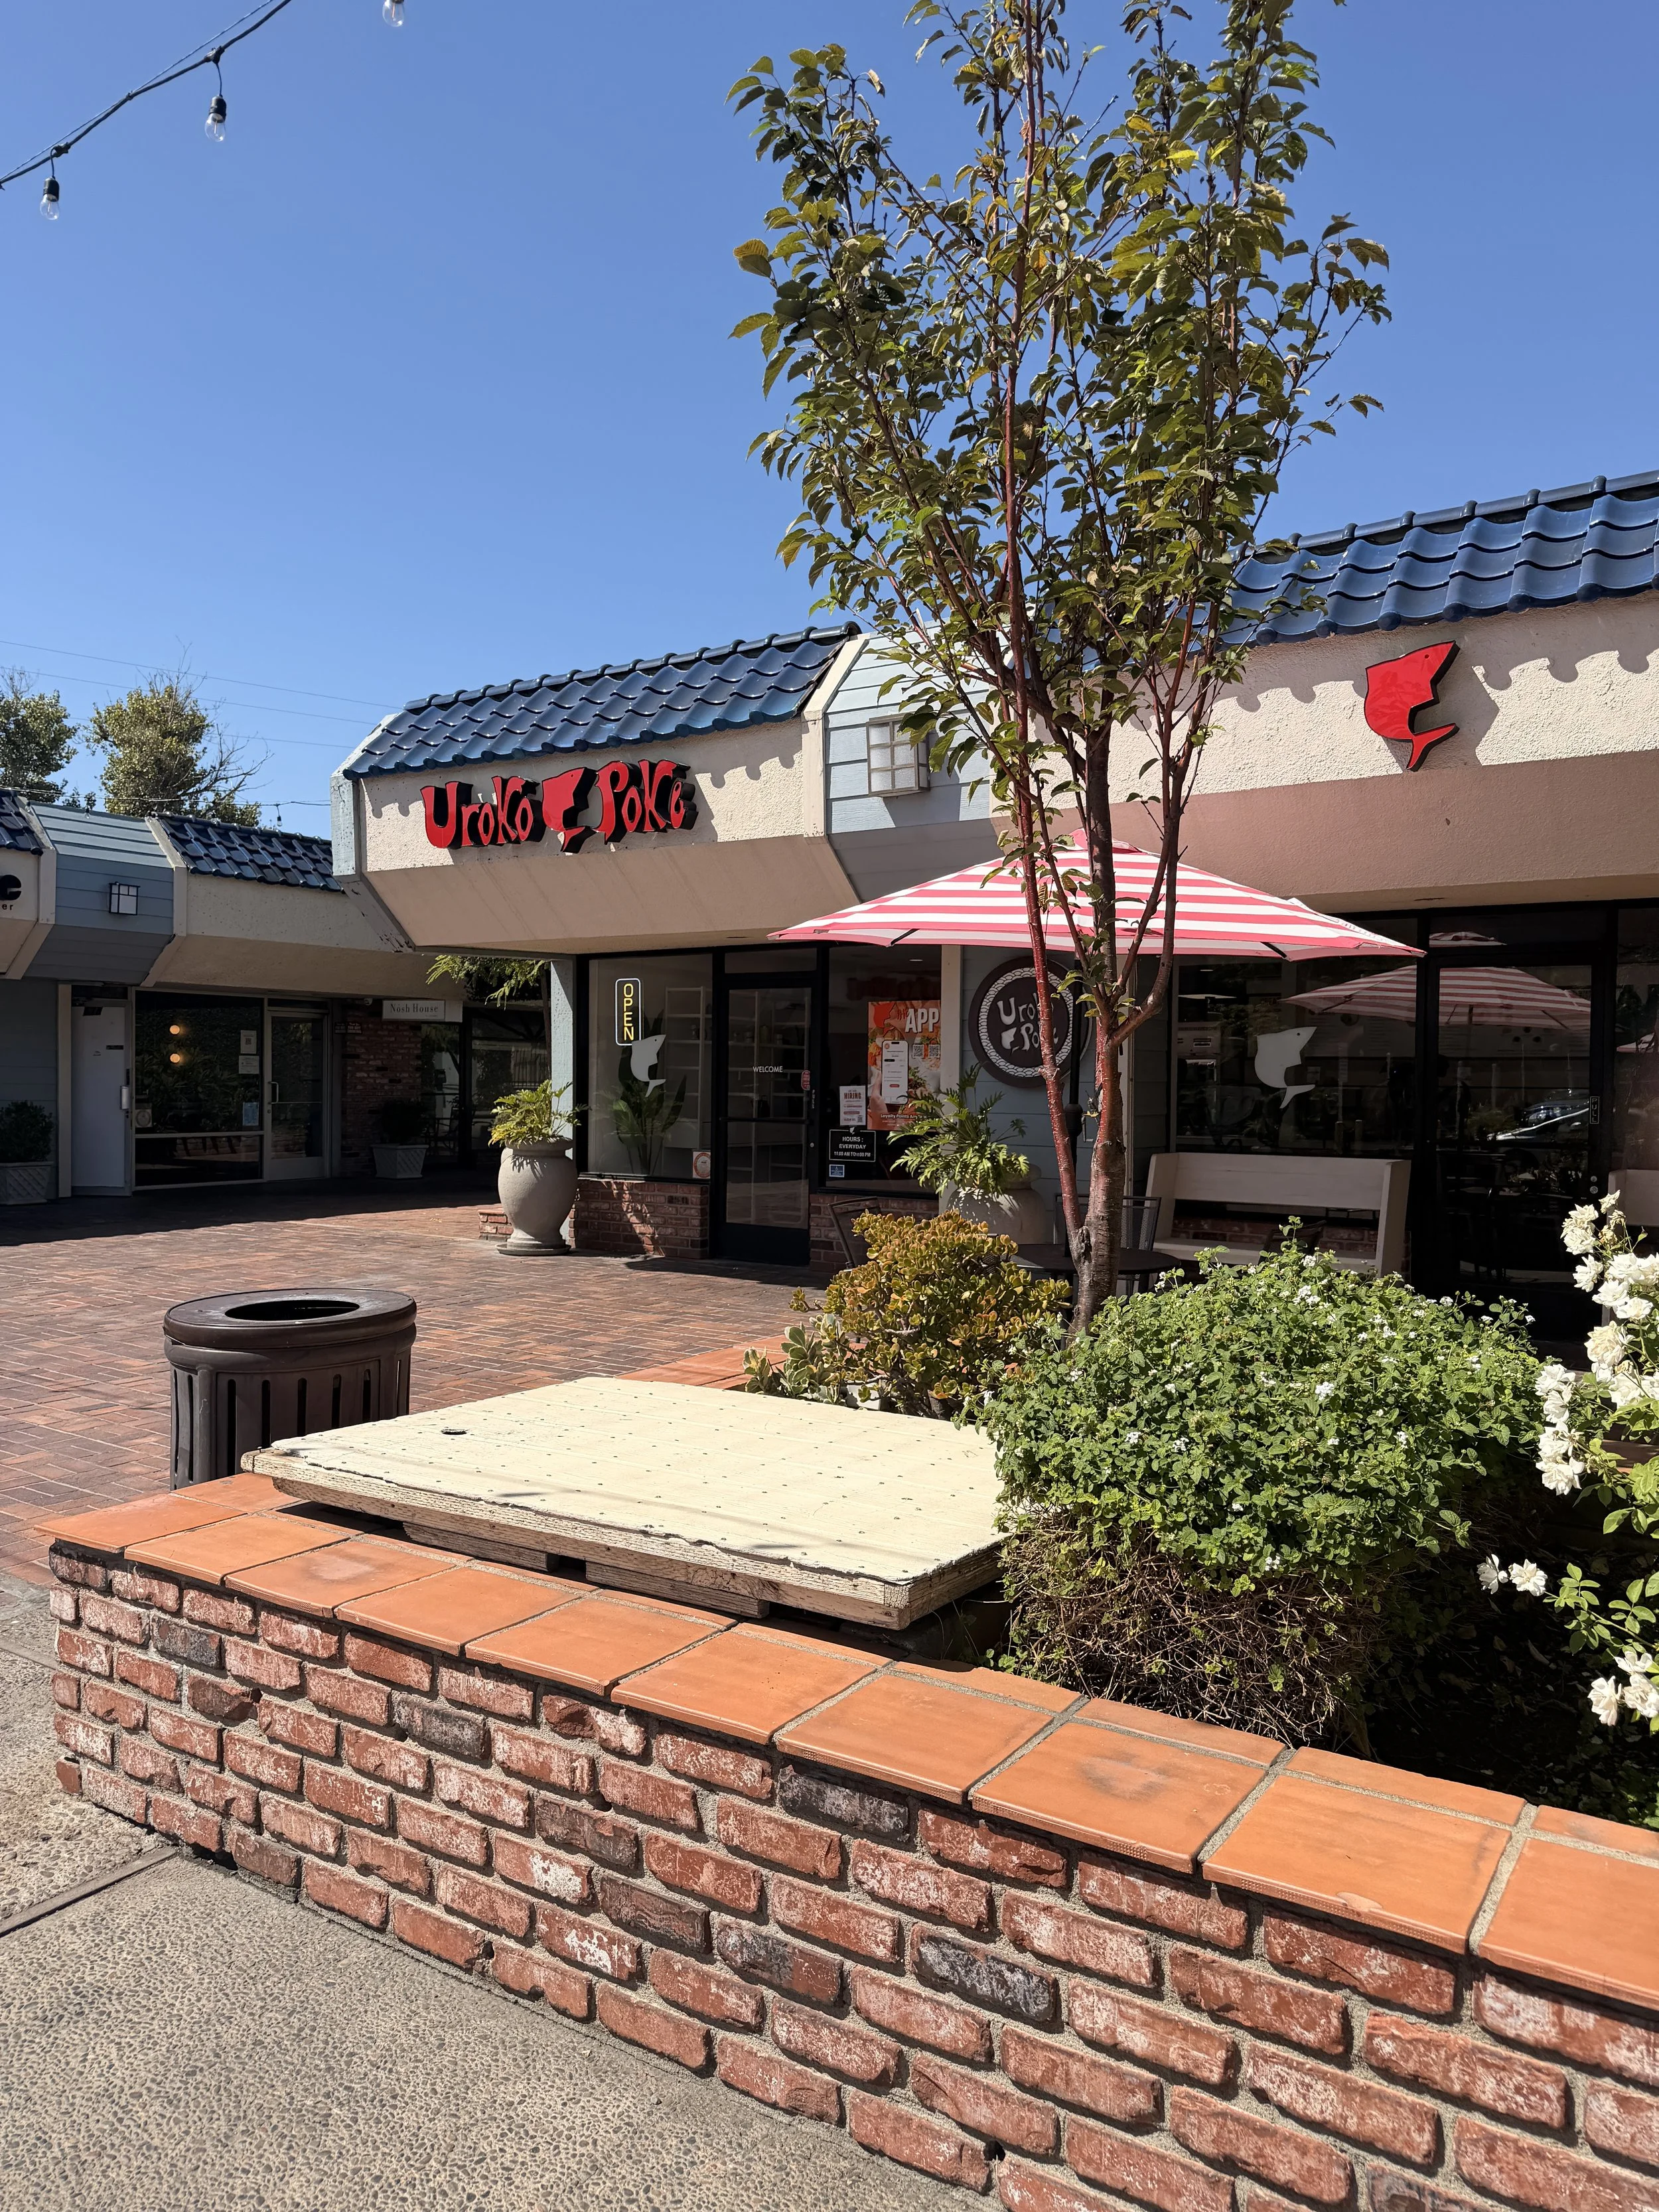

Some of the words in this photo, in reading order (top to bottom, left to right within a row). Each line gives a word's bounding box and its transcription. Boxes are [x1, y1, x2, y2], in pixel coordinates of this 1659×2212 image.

[413, 1003, 438, 1013] House
[624, 983, 634, 1041] OPEN
[904, 1008, 940, 1033] APP
